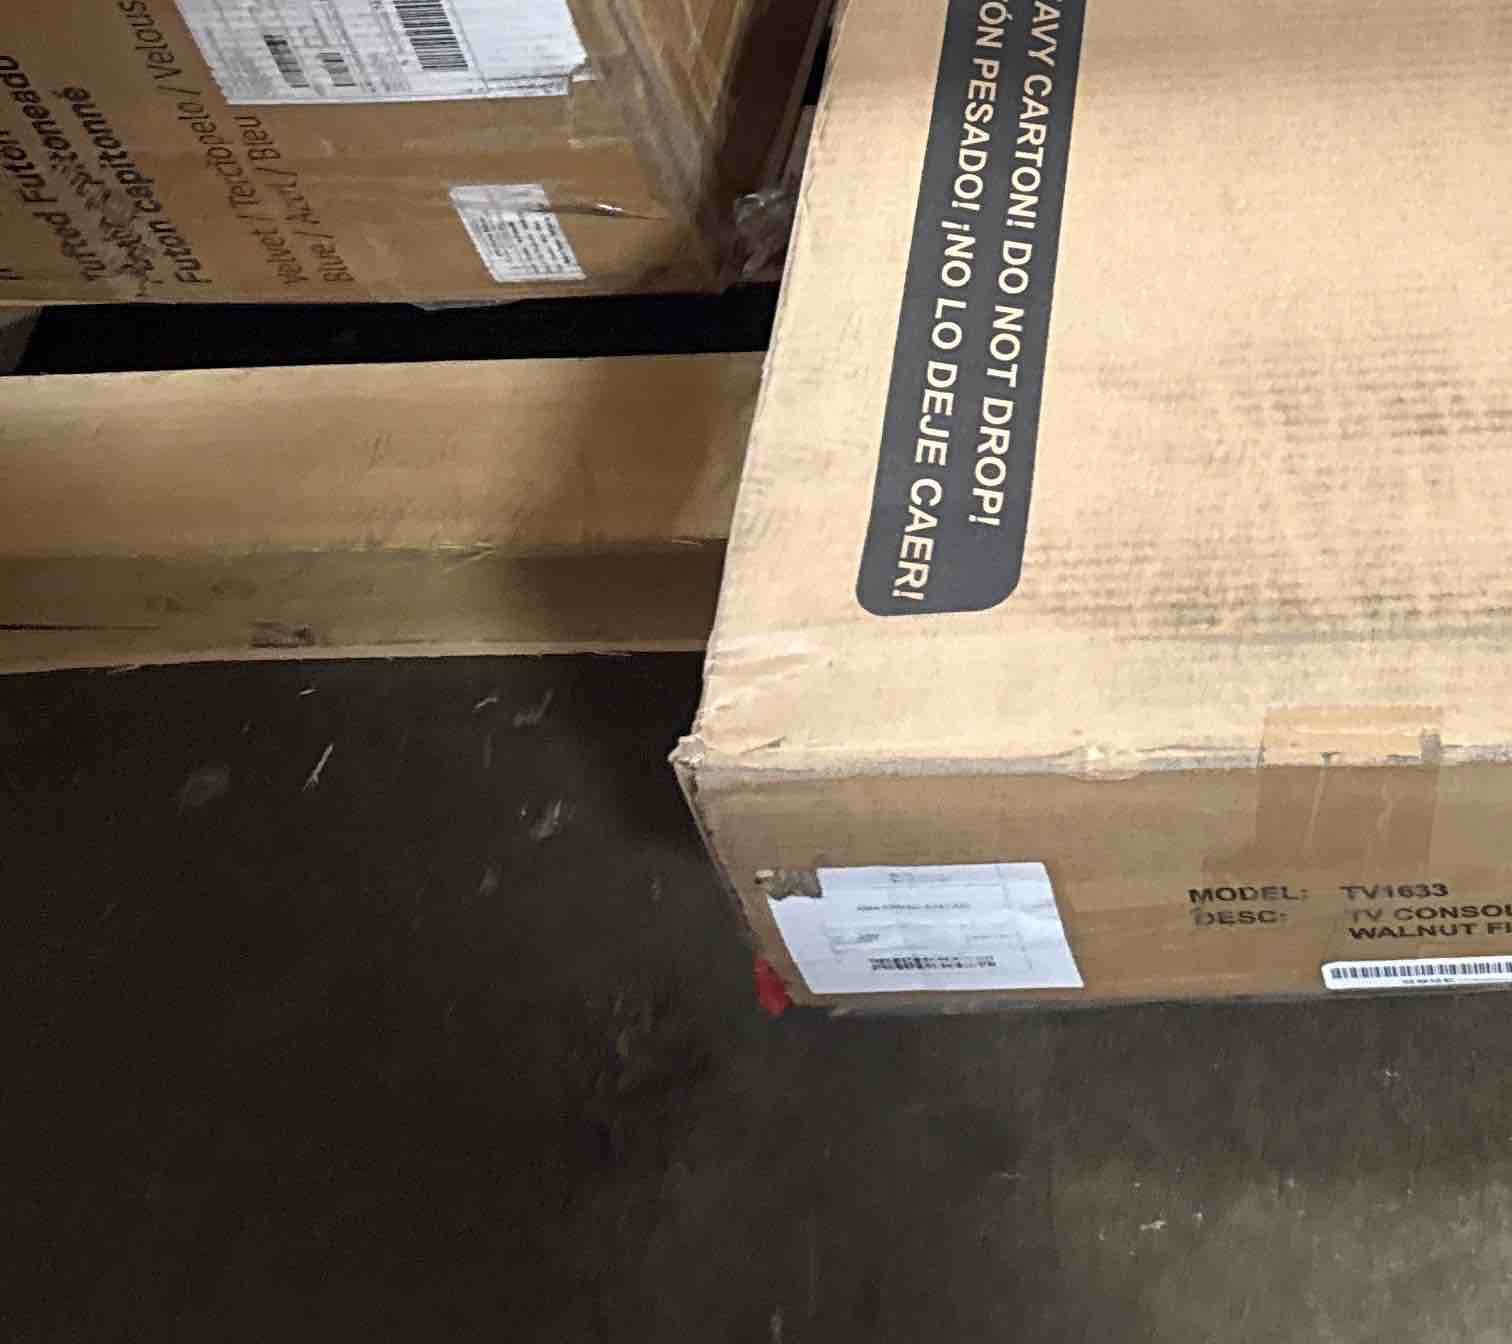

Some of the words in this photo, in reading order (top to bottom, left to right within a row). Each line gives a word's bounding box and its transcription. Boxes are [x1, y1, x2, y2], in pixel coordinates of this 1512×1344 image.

[52, 86, 163, 212] capitonné
[177, 101, 261, 210] Terciopelo
[234, 115, 281, 161] Bleu
[952, 57, 1000, 211] PESADO!
[1006, 74, 1053, 230] CARTON!
[148, 219, 213, 284] Futon
[251, 225, 308, 285] Velvet
[310, 241, 355, 283] Blue
[941, 220, 977, 288] ¡NO
[998, 239, 1033, 295] DO
[931, 297, 967, 350] LO
[986, 305, 1025, 388] NOT
[915, 360, 959, 466] DEJE
[968, 395, 1015, 526] DROP!
[891, 477, 944, 601] CAER!
[1188, 886, 1310, 905] MODEL:
[1339, 883, 1449, 902] TV1633
[1194, 909, 1289, 926] DESC:
[1351, 907, 1382, 923] TV
[1348, 922, 1480, 940] WALNUT
